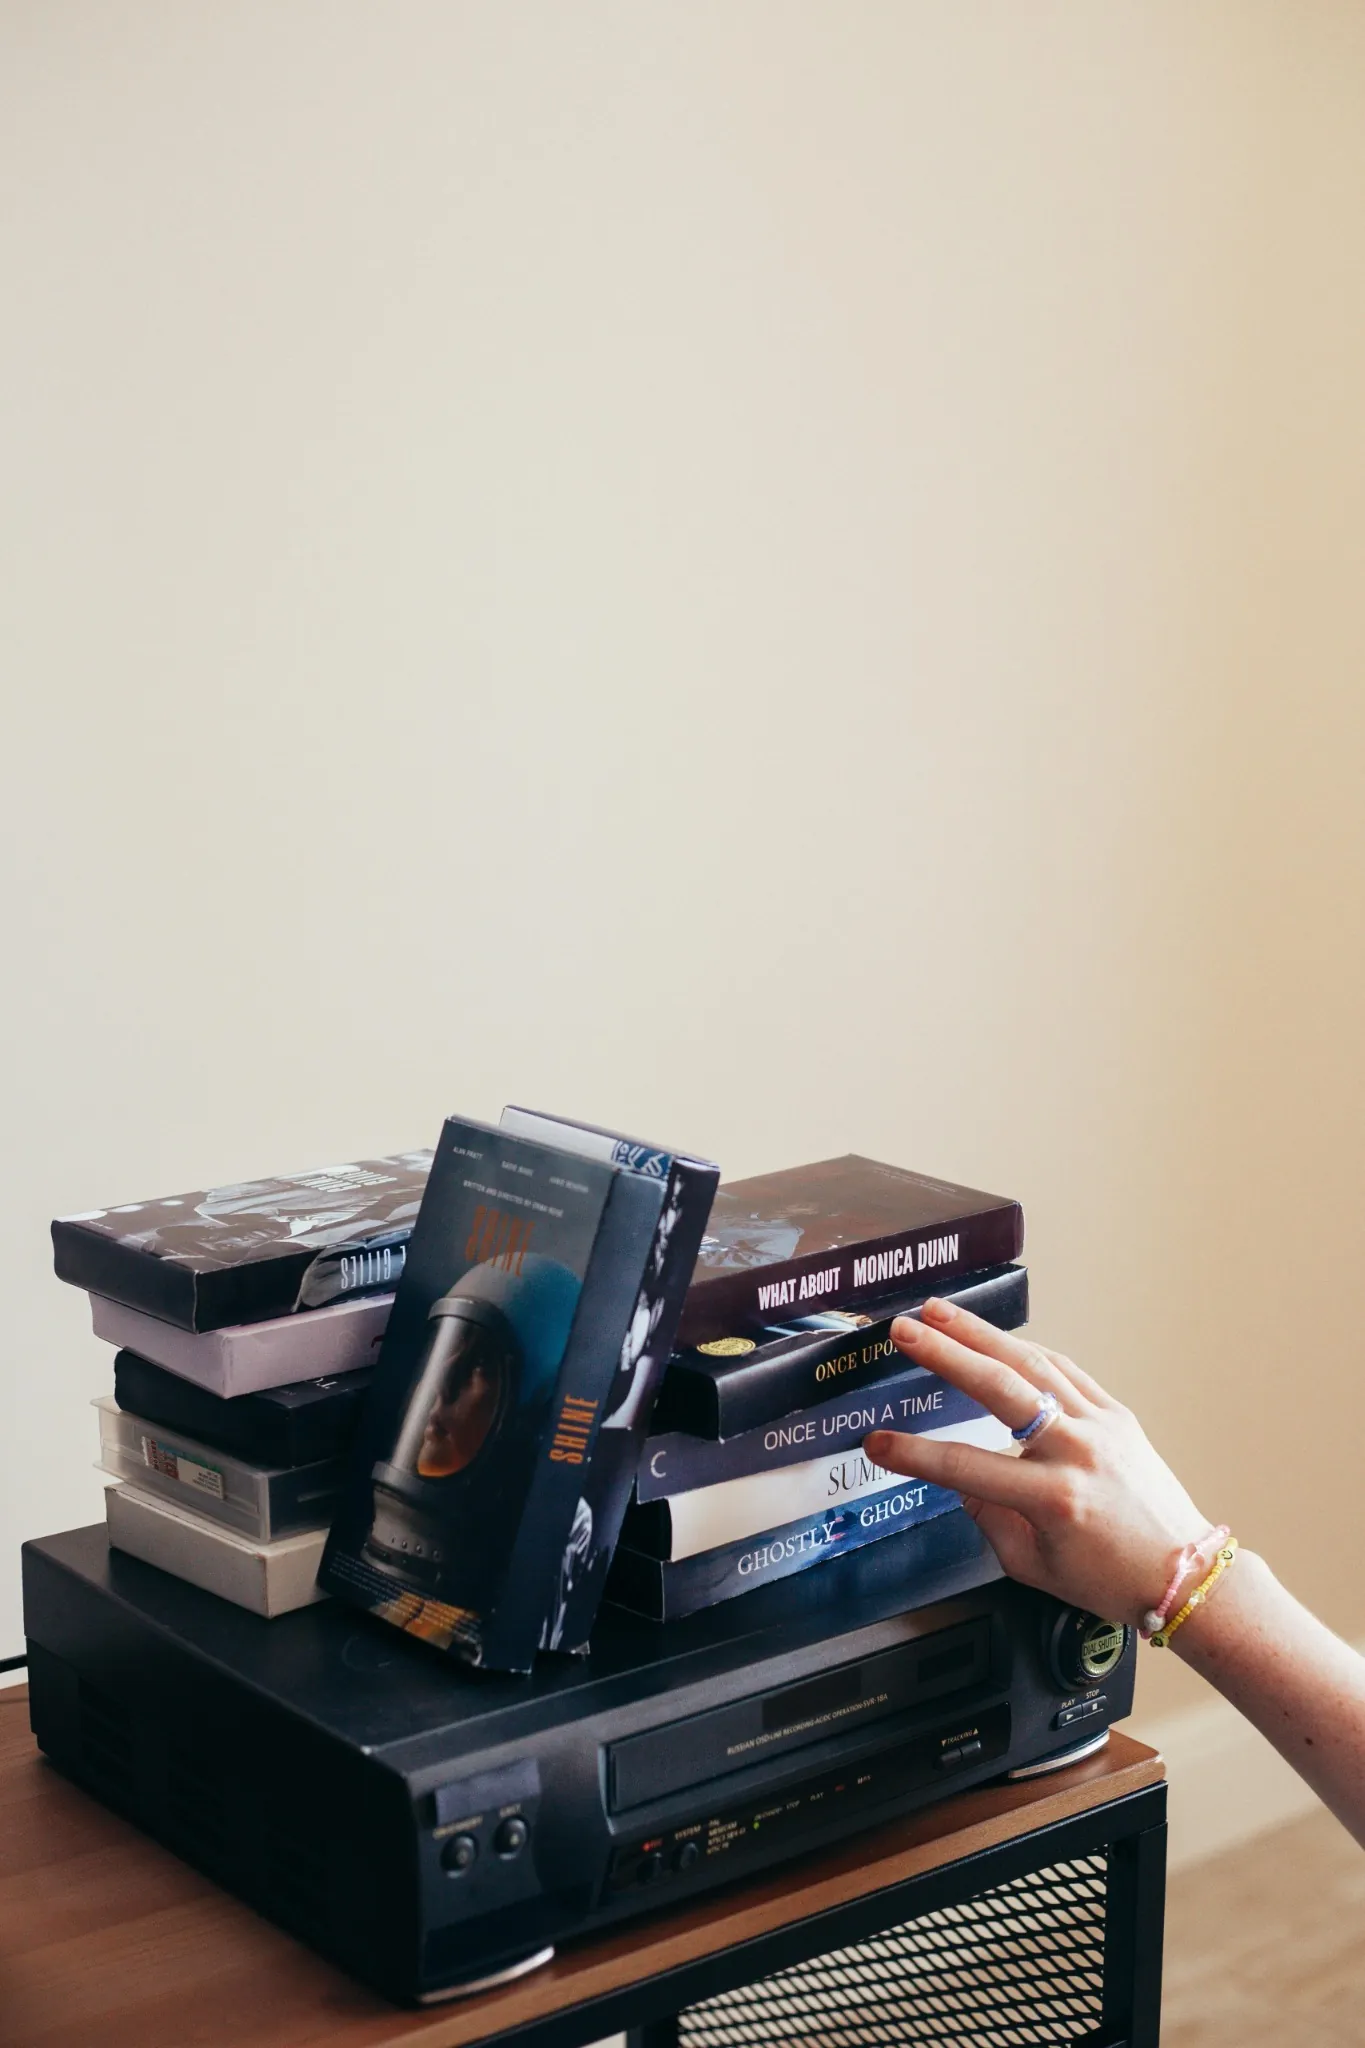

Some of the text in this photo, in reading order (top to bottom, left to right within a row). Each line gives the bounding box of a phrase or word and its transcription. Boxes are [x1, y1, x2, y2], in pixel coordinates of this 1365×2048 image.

[465, 1204, 535, 1277] SHINE
[340, 1247, 391, 1289] CITIES
[758, 1234, 959, 1311] WHAT ABOUT MONICA DUNN
[815, 1339, 898, 1382] ONCE UPO
[549, 1393, 599, 1464] SHINE
[764, 1391, 943, 1450] ONCE UPON A TIME
[737, 1485, 928, 1575] GHOSTLY GHOST
[1083, 1642, 1097, 1657] DIAL
[1098, 1632, 1122, 1652] SHUTTLE
[1061, 1698, 1076, 1709] PLAY
[1086, 1688, 1100, 1700] STOP
[726, 1738, 756, 1756] RUSSIAN
[947, 1730, 973, 1745] TRACKING
